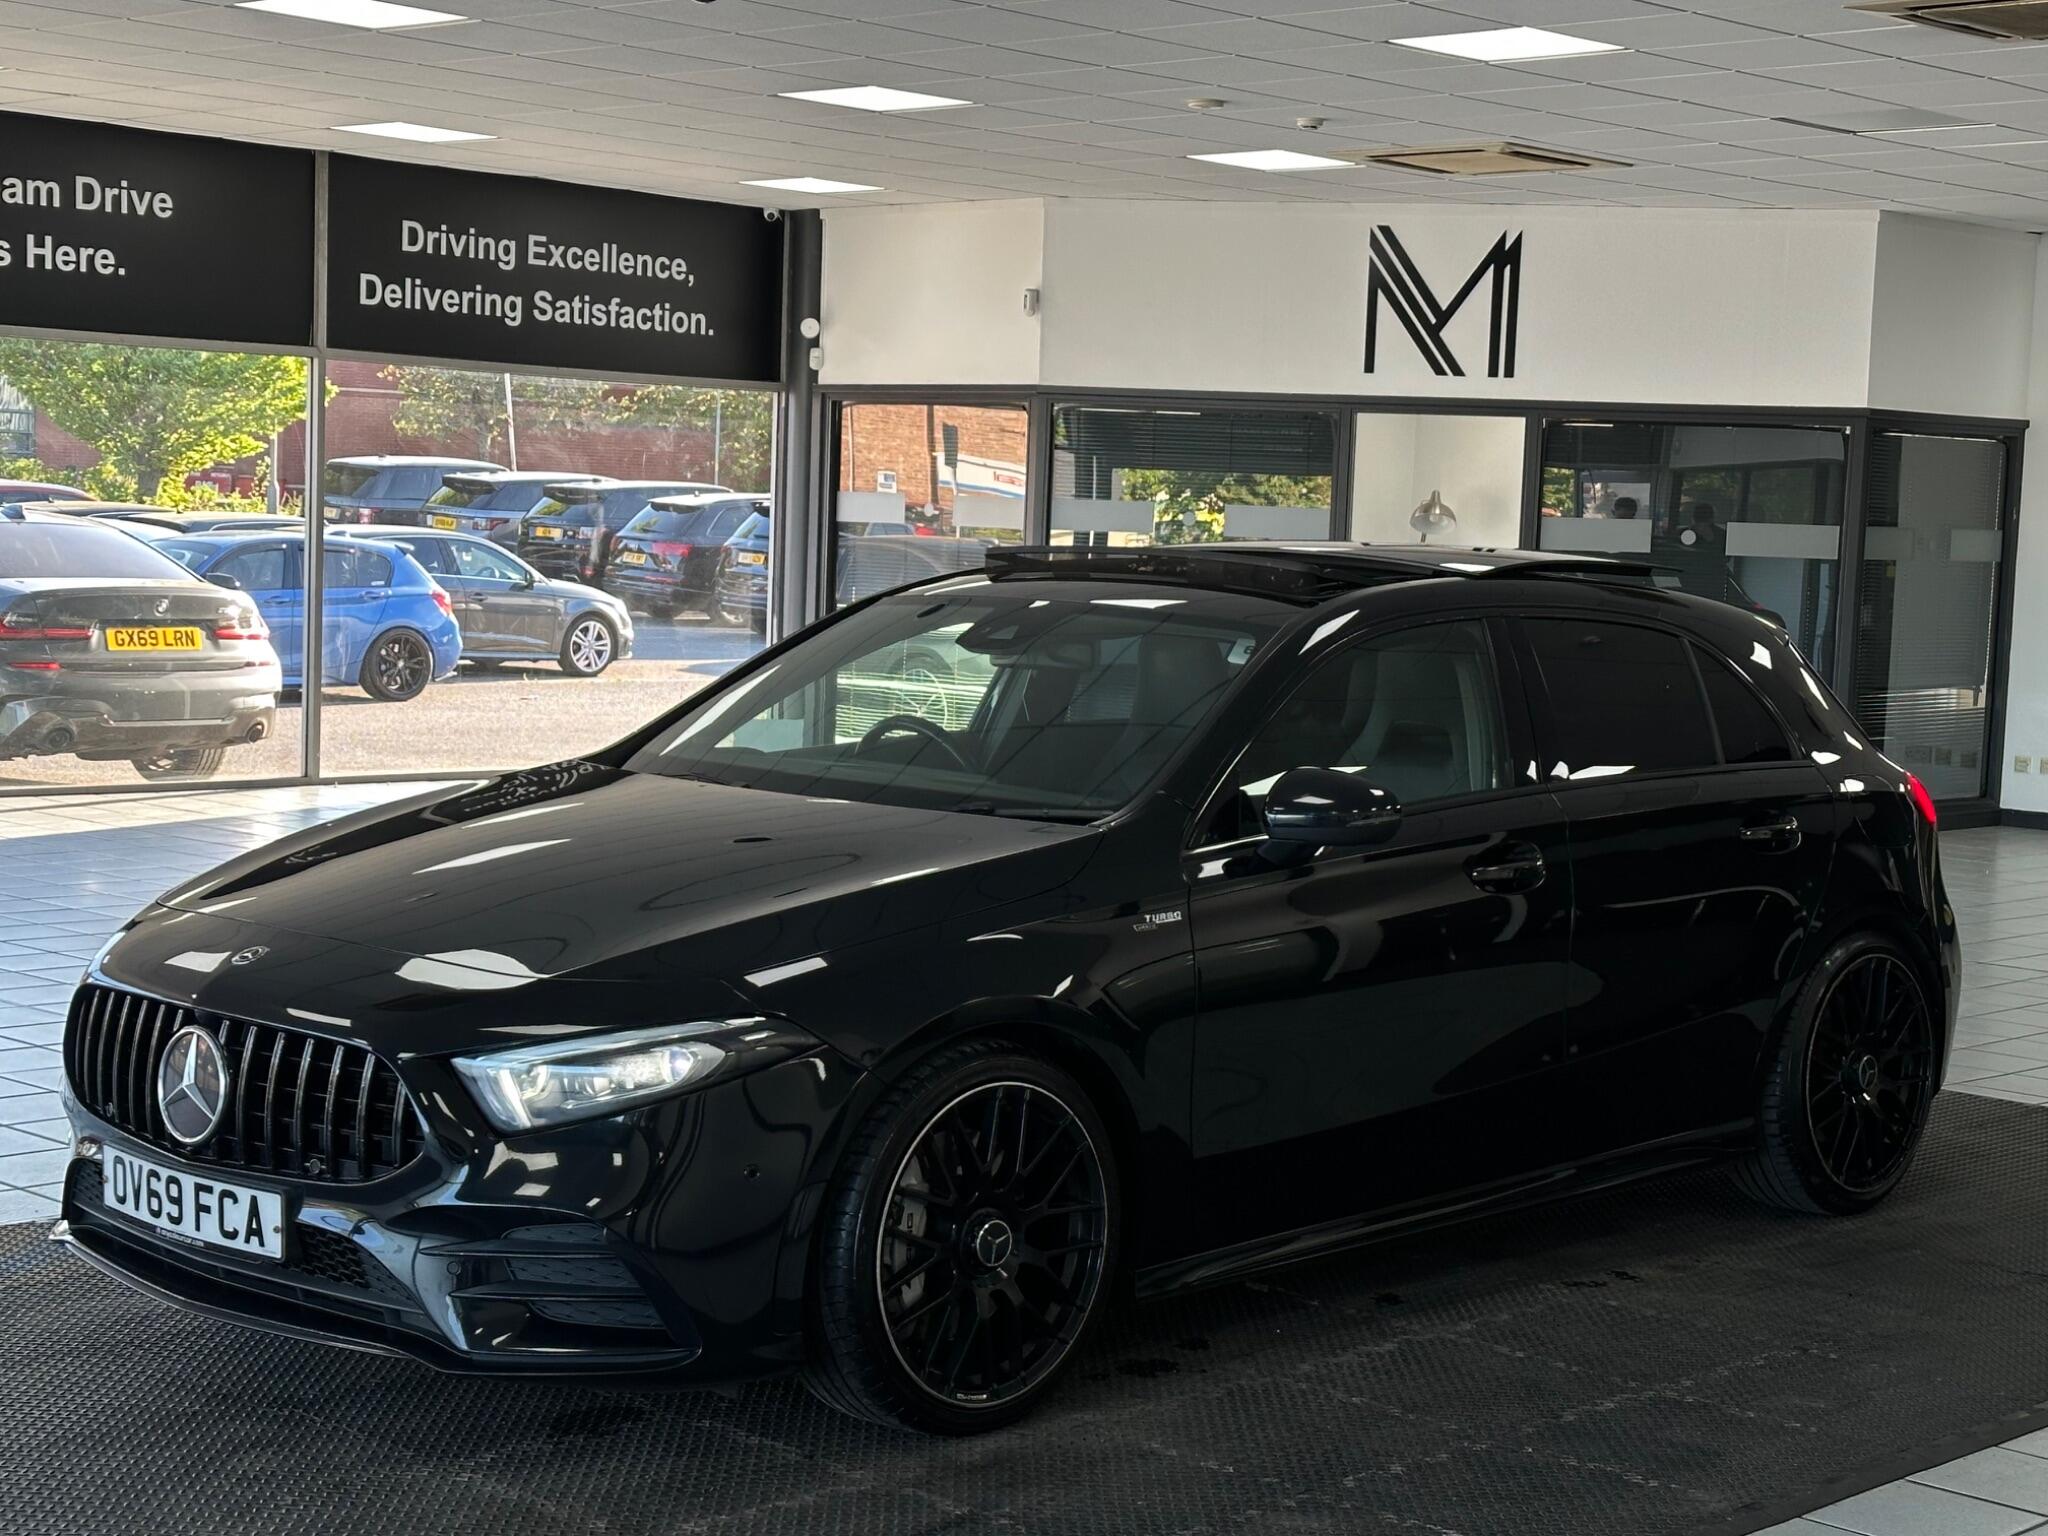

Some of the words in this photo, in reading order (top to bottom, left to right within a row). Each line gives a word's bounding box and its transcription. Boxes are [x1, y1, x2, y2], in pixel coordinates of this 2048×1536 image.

[75, 175, 174, 218] Drive
[26, 233, 126, 276] Here.
[401, 219, 516, 271] Driving
[527, 233, 695, 287] Excellence,
[359, 272, 522, 327] Delivering
[532, 289, 715, 336] Satisfaction.
[114, 630, 159, 647] GX69
[162, 629, 196, 647] LRN
[1143, 910, 1182, 923] TURBO
[113, 1155, 183, 1226] OV69
[194, 1181, 265, 1248] FCA
